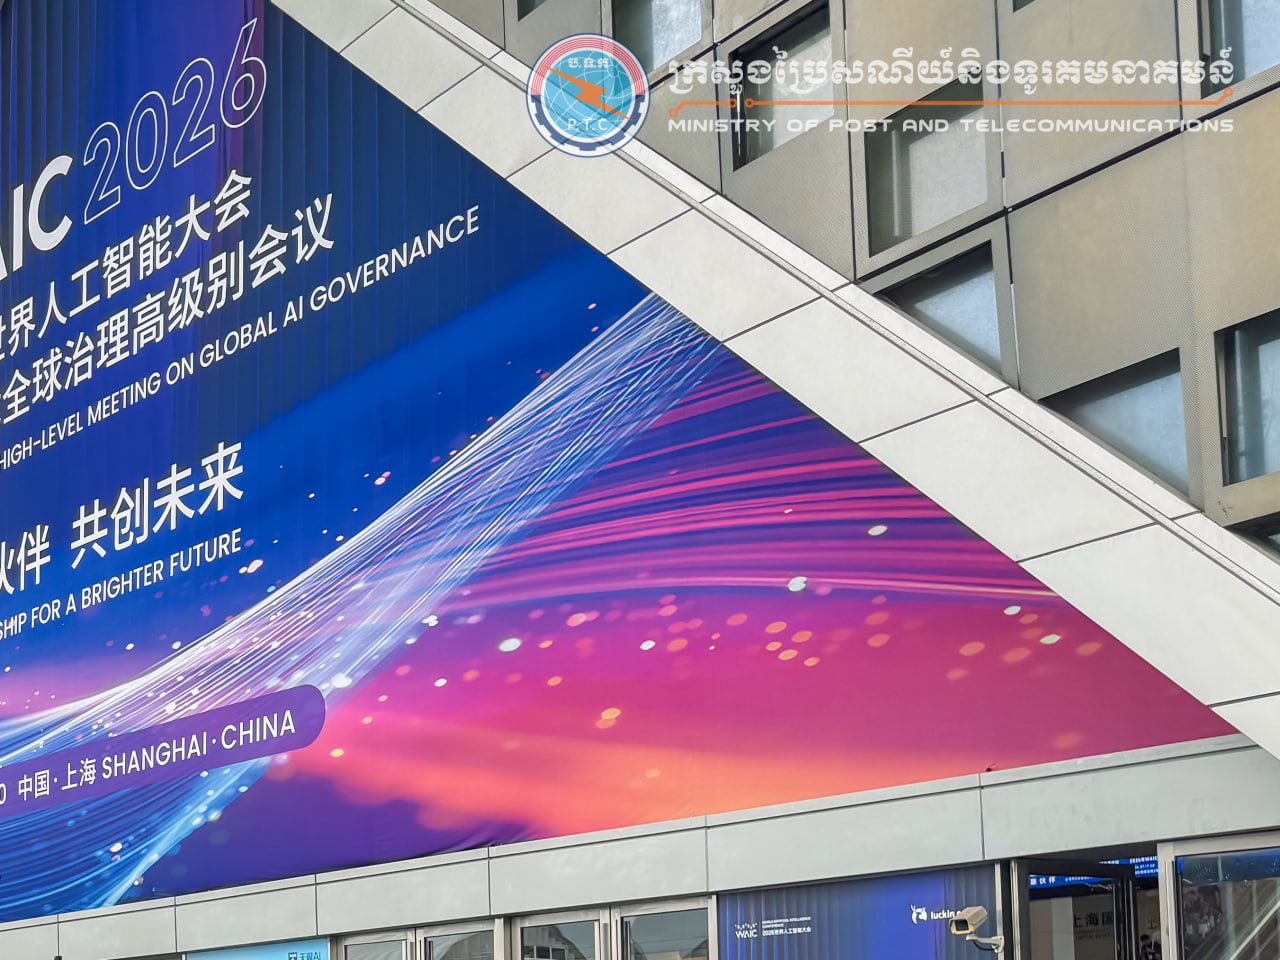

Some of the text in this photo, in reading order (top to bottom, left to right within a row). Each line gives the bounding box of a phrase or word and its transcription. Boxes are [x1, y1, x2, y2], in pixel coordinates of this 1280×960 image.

[82, 18, 268, 226] 2026
[87, 373, 162, 433] MEETING
[165, 356, 195, 387] ON
[199, 311, 279, 370] GLOBAL
[282, 300, 306, 330] AI
[309, 205, 481, 313] GOVERNANCE
[70, 441, 244, 570] 共创未来
[31, 603, 62, 629] FOR
[65, 597, 78, 616] A
[80, 562, 164, 610] BRIGHTER
[169, 528, 243, 577] FUTURE
[735, 929, 758, 939] WAIC
[930, 909, 955, 920] luckin
